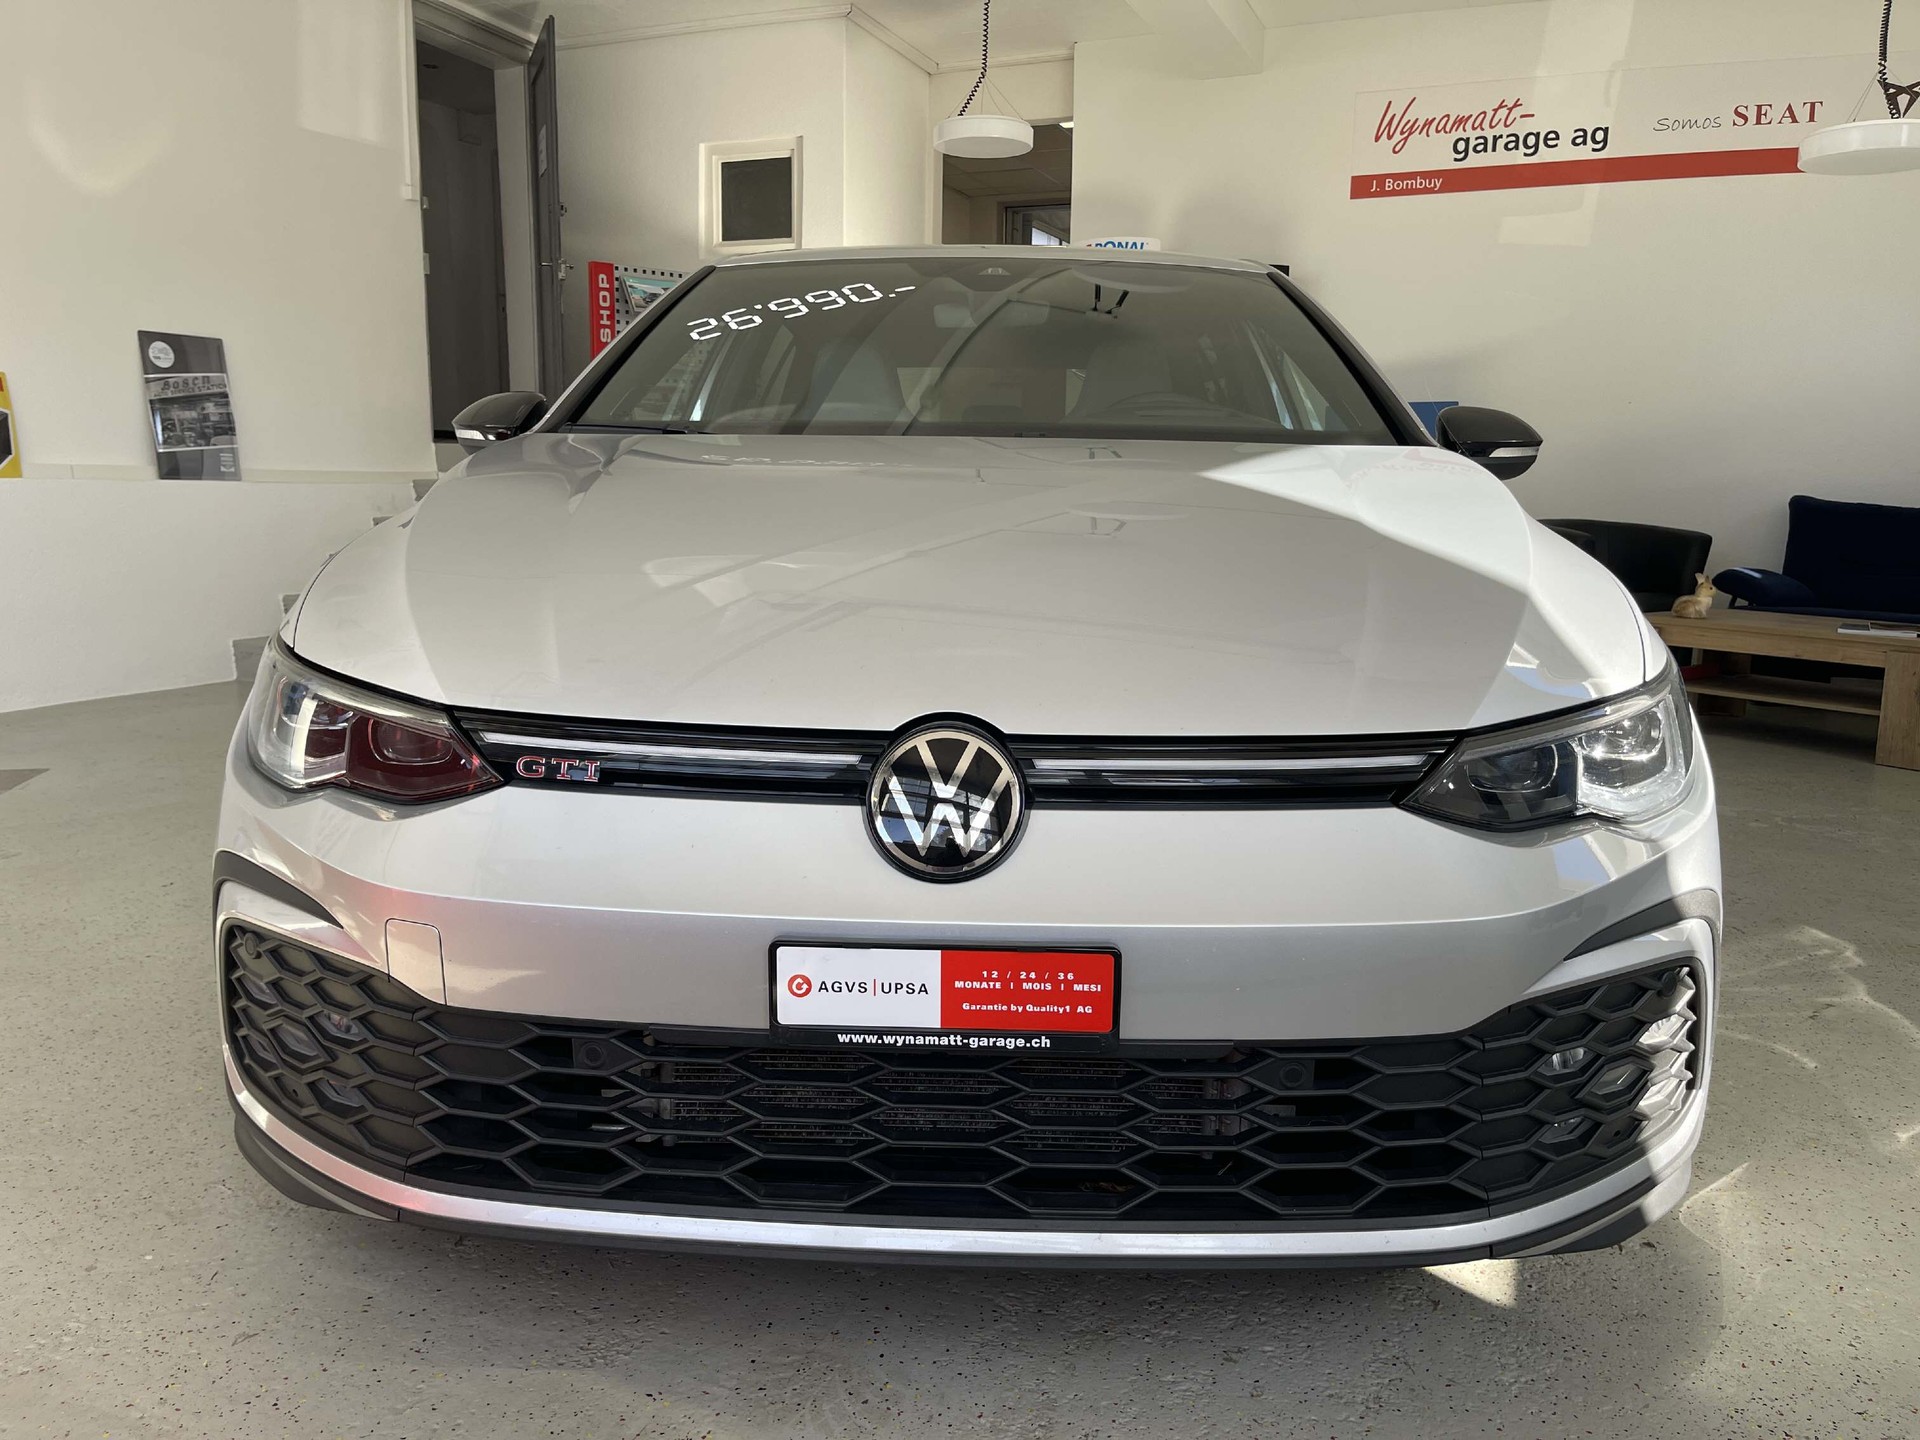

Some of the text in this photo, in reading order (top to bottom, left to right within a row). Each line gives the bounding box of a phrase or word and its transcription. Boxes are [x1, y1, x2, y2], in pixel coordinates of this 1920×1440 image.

[1732, 100, 1823, 127] SEAT
[1373, 97, 1536, 155] Wynamatt-
[1452, 125, 1610, 162] garage ag
[1370, 175, 1443, 193] J. Bombuy
[598, 273, 612, 343] SHOP
[516, 755, 601, 783] GTI
[954, 980, 1002, 990] MONATE
[1022, 982, 1052, 991] MOIS
[1073, 984, 1102, 992] MESI
[981, 970, 999, 979] 12
[1019, 971, 1037, 980] 24
[1057, 972, 1075, 981] 36
[962, 1002, 1093, 1014] Garantie by Quality1 AG
[837, 1032, 1051, 1049] www.wynamatt-garage.ch
